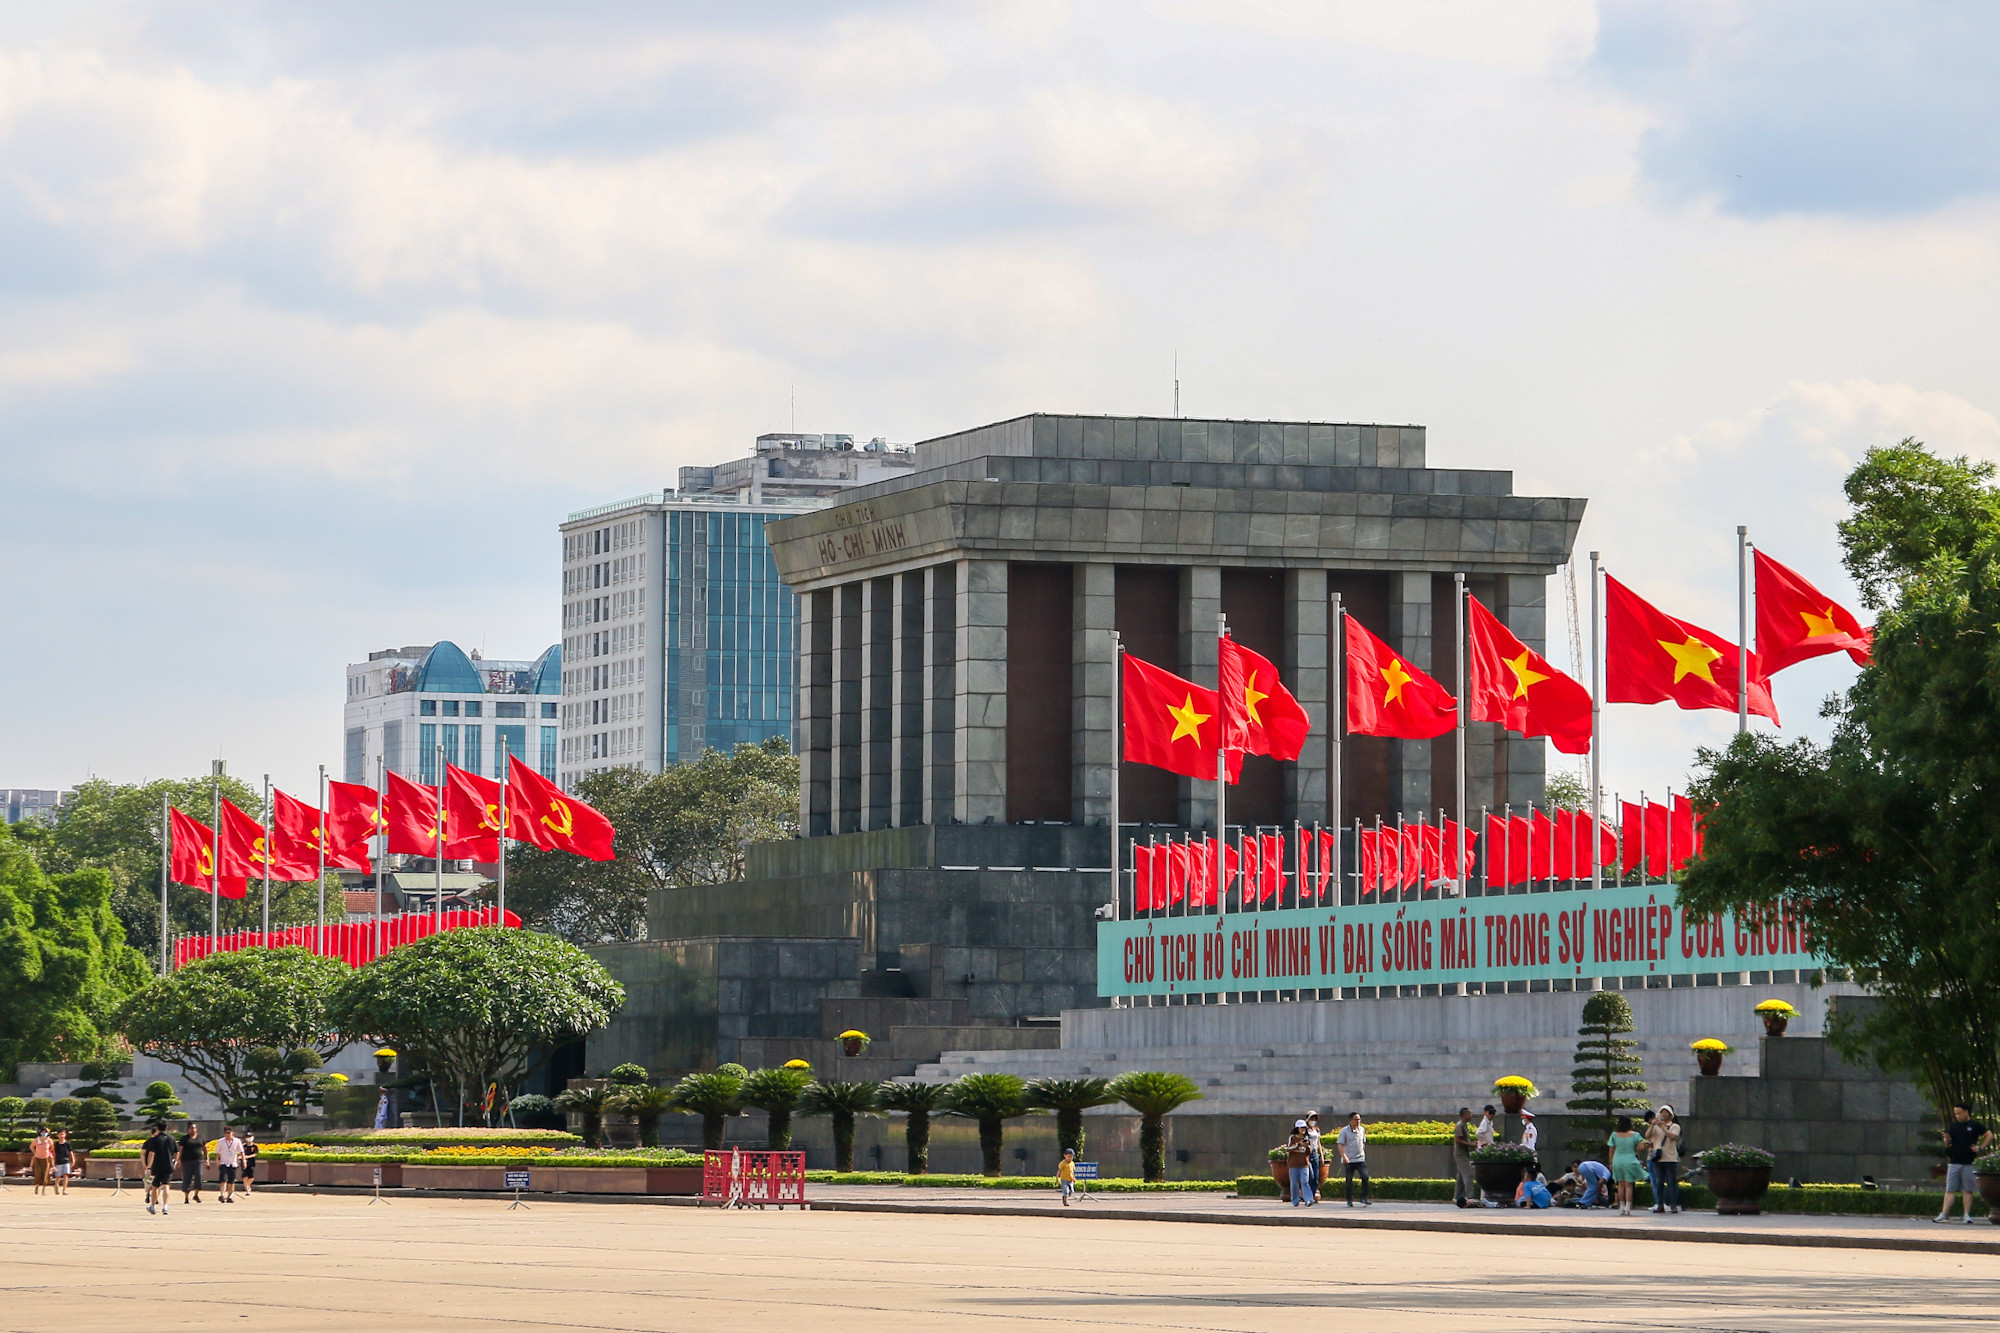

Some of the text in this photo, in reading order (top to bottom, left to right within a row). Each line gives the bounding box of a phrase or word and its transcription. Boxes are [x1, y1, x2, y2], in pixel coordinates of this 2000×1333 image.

[1124, 922, 1155, 983] CHỦ
[1161, 933, 1197, 991] TỊCH
[1203, 917, 1224, 980] HỒ
[1231, 919, 1259, 979] CHÍ
[1266, 926, 1311, 977] MINH
[1318, 915, 1336, 975] VĨ
[1343, 923, 1373, 983] ĐẠI
[1381, 905, 1432, 972] SỐNG
[1440, 906, 1476, 970] MÃI
[1485, 912, 1550, 968] TRONG
[1558, 902, 1587, 974] SỰ
[1594, 894, 1672, 971] NGHIỆP
